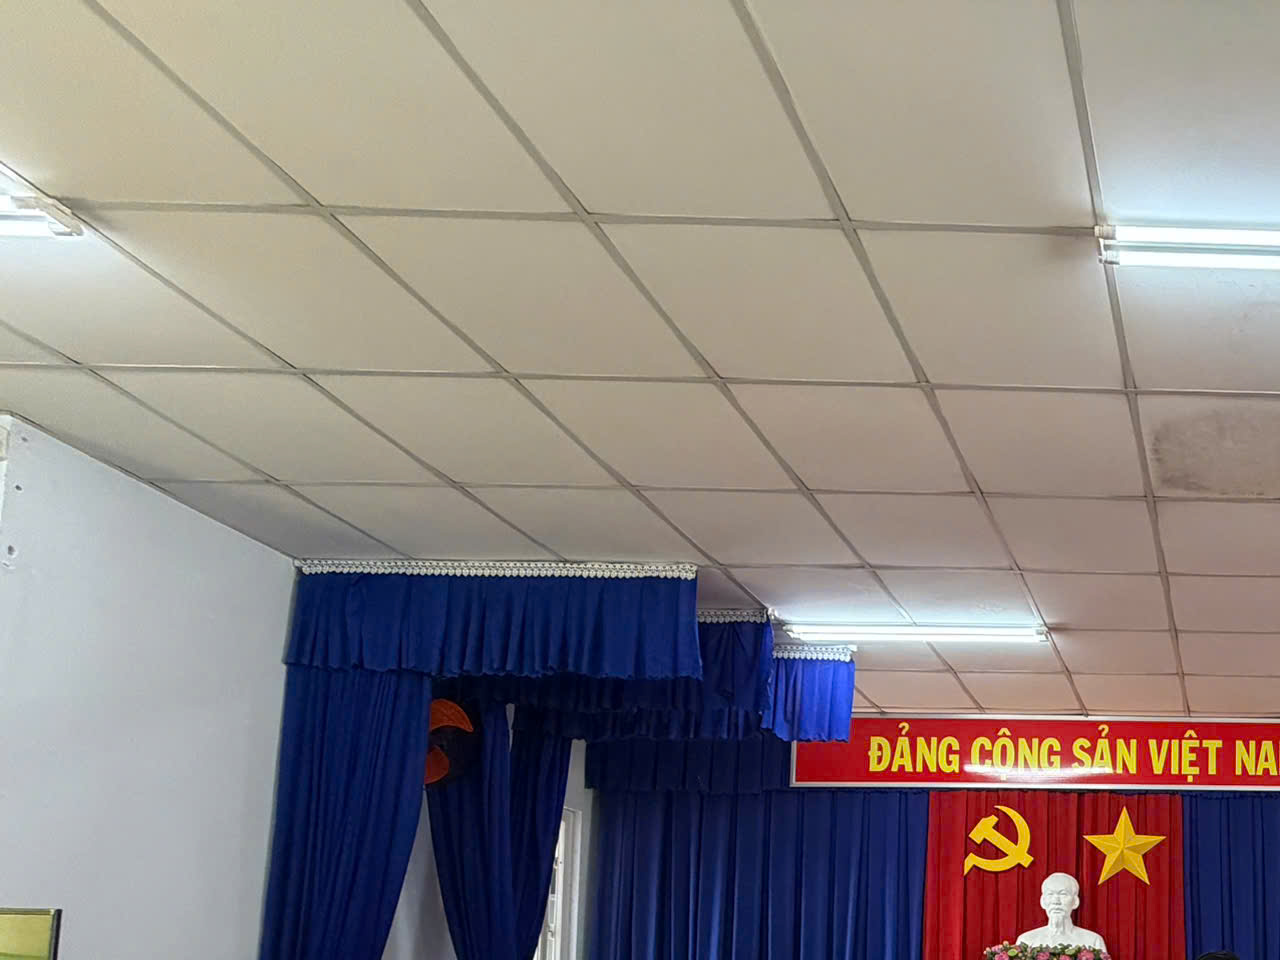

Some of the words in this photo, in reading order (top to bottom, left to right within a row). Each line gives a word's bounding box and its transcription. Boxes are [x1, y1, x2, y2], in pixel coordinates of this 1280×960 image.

[868, 722, 960, 773] ĐẢNG
[971, 727, 1061, 780] CỘNG
[1072, 724, 1137, 774] SẢN
[1148, 729, 1222, 782] VIỆT
